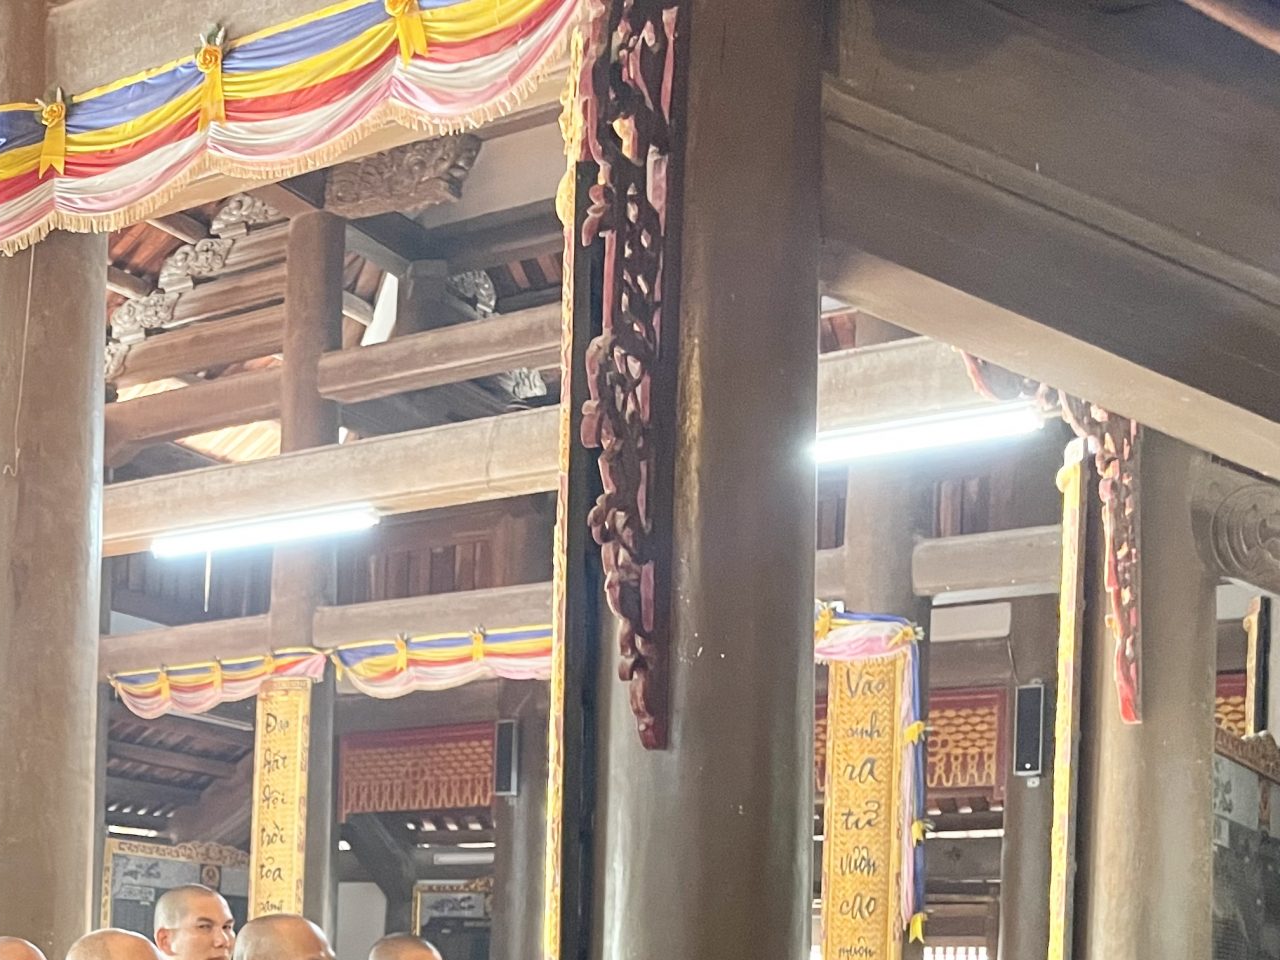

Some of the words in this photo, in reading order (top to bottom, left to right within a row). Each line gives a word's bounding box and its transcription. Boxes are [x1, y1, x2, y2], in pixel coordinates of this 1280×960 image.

[845, 664, 885, 698] Vào
[847, 711, 881, 740] sinh
[843, 756, 883, 784] ra
[841, 800, 881, 830] tử
[839, 892, 877, 920] cao
